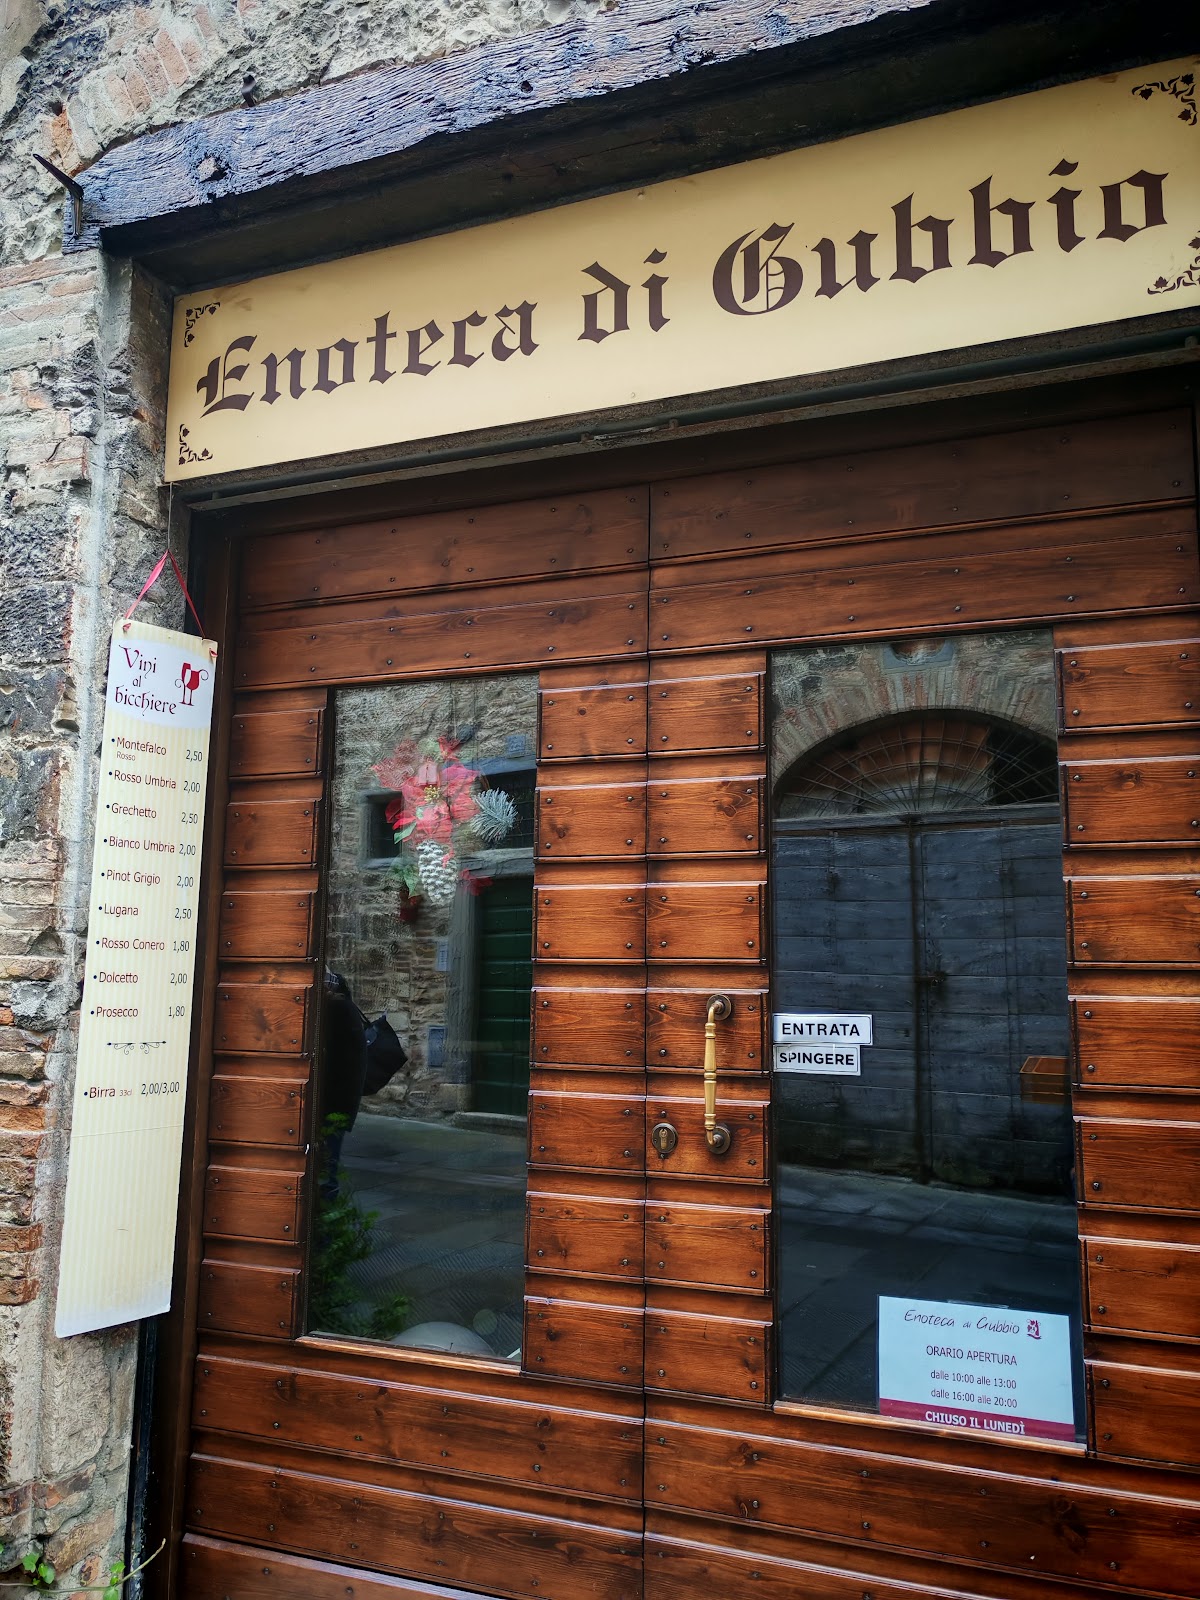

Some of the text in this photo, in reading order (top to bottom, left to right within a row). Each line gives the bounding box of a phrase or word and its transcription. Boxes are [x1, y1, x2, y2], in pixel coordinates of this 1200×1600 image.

[197, 159, 1169, 418] Enoteca di Gubbio
[118, 645, 157, 679] Vini
[133, 675, 141, 687] al
[115, 686, 177, 716] bicchiere
[117, 736, 203, 762] Montefalco 2,50
[117, 753, 135, 761] Rosso
[114, 770, 200, 793] Rosso Umbria 2,00
[111, 802, 198, 824] Grechetto 2,50
[109, 836, 196, 856] Bianco Umbria 2,00
[106, 870, 193, 888] Pinot Grigio 2,00
[104, 903, 192, 920] Lugana 2,50
[102, 938, 189, 952] Rosso Conero 1,80
[99, 972, 187, 984] Dolcetto 2,00
[96, 1006, 185, 1017] Prosecco 1,80
[782, 1023, 860, 1036] ENTRATA
[780, 1052, 854, 1065] SPINGERE
[90, 1087, 115, 1098] Birra
[141, 1081, 179, 1096] 2,00/3,00
[904, 1310, 955, 1327] Enoteca
[976, 1317, 1019, 1334] Gubbio
[926, 1345, 1017, 1366] ORARIO APERTURA
[931, 1370, 1016, 1389] dalle 10:00 alle 13:00
[931, 1389, 1017, 1408] dalle 16:00 alle 20:00
[925, 1411, 1025, 1435] CHIUSO IL LUNEDÌ
